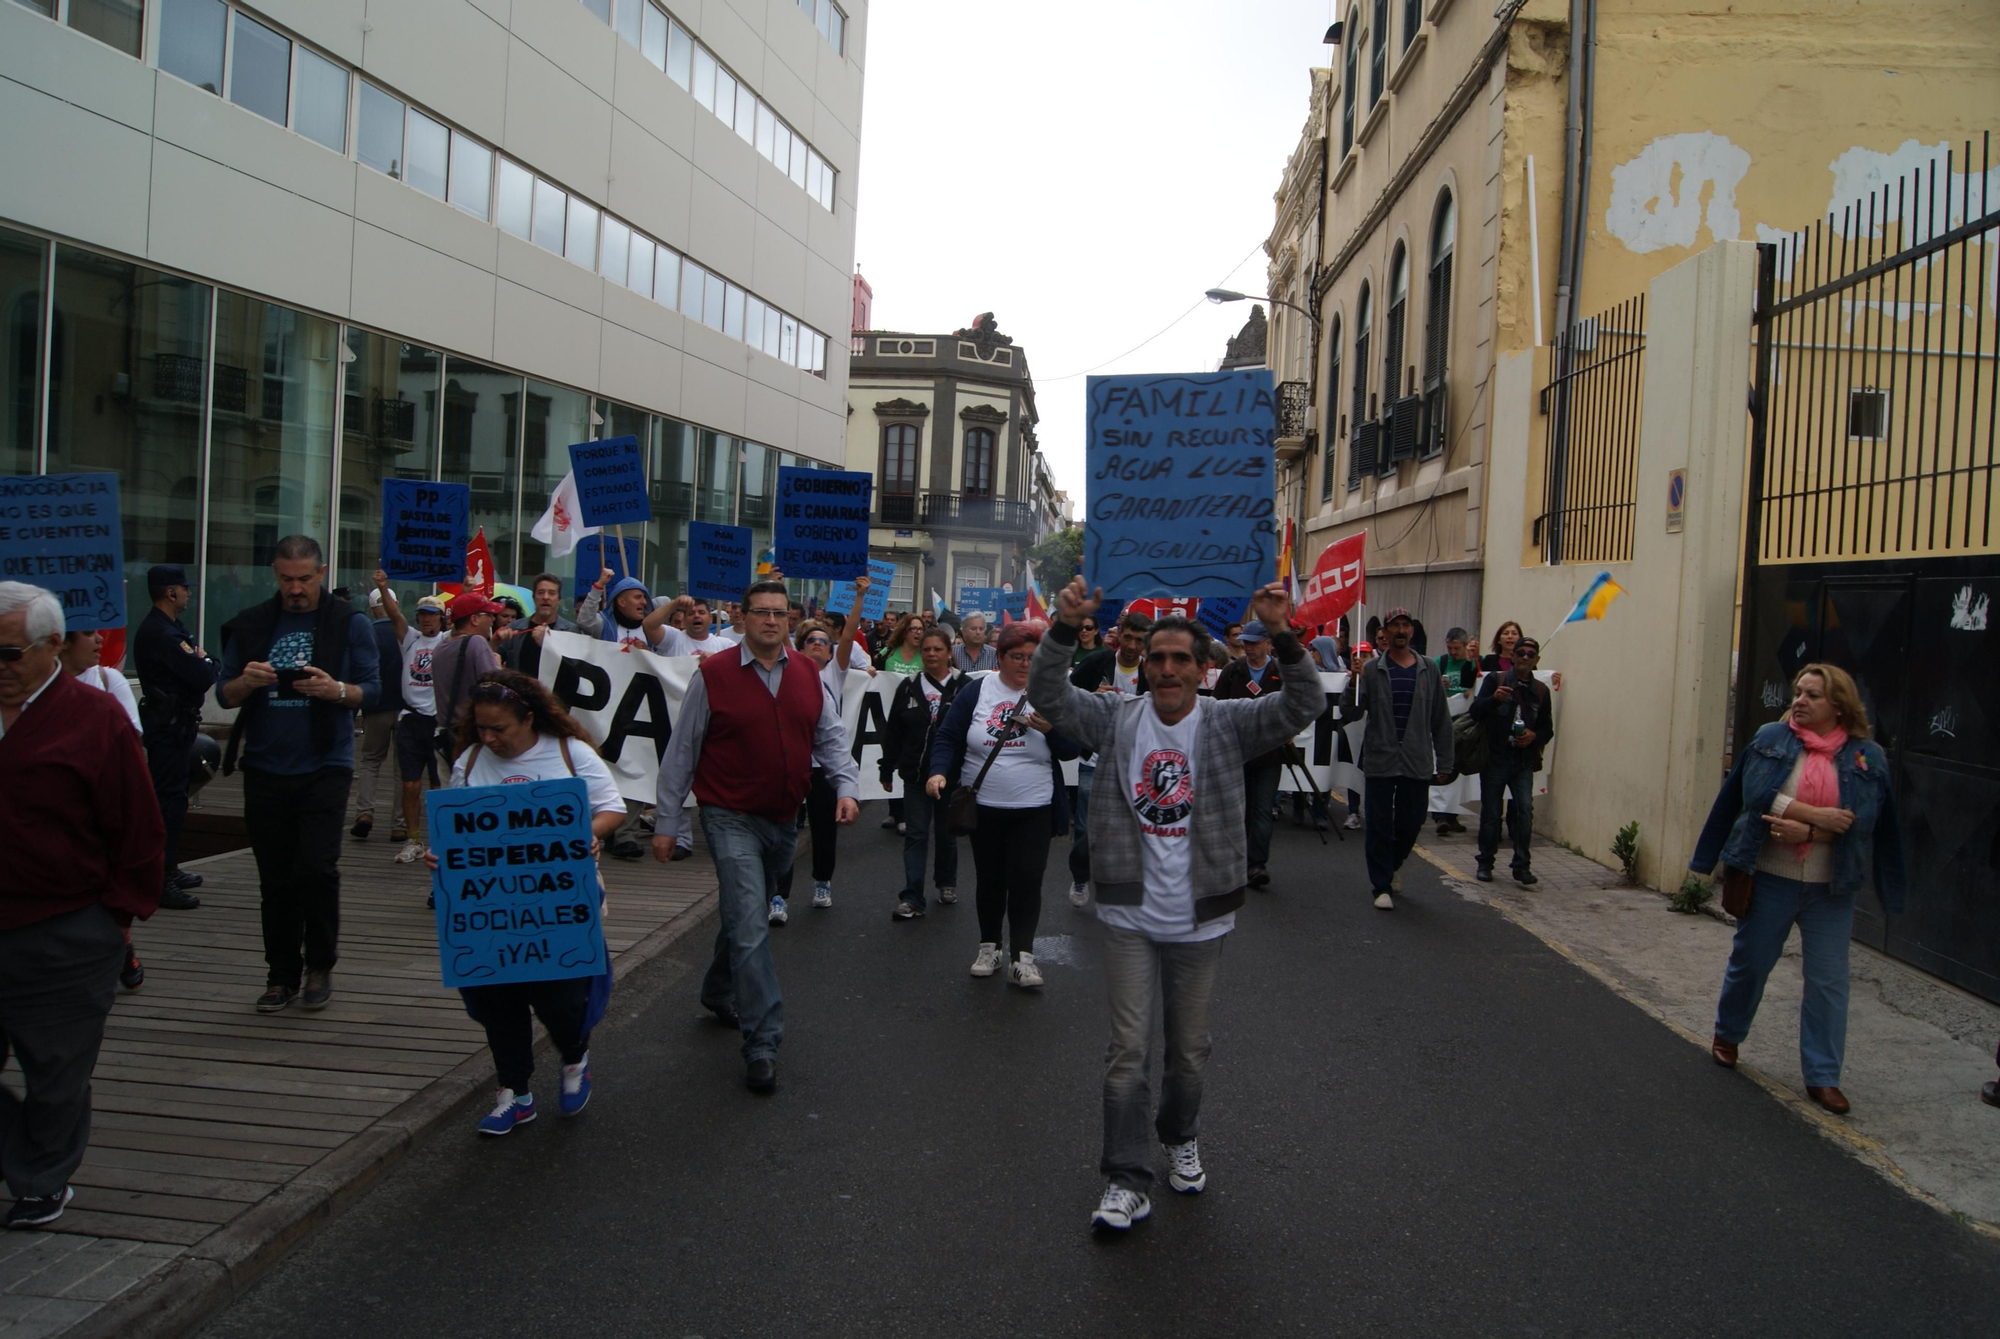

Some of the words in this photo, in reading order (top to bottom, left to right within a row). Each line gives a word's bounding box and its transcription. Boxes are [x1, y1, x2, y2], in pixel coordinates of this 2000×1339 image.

[1102, 387, 1274, 417] FAMILIA
[1103, 419, 1152, 447] SIN
[576, 446, 618, 461] PORQUE
[625, 444, 638, 453] NO
[584, 462, 636, 478] COMEMOS
[1095, 454, 1173, 480] AGUA
[1187, 456, 1266, 478] LUZ
[416, 488, 439, 509] PP
[584, 482, 640, 498] ESTAMOS
[27, 505, 51, 518] ES
[57, 503, 97, 517] QUE
[592, 499, 640, 515] HARTOS
[783, 503, 800, 519] DE
[804, 504, 870, 522] CANARIAS
[401, 510, 435, 523] BASTA
[437, 513, 451, 523] DE
[17, 525, 109, 539] CUENTEN
[714, 531, 734, 540] PAN
[794, 524, 858, 541] GOBIERNO
[399, 544, 433, 557] BASTA
[434, 546, 451, 558] DE
[702, 541, 746, 555] TRABAJO
[4, 556, 34, 575] QUE
[58, 554, 115, 574] TENGAN
[706, 555, 740, 568] TECHO
[783, 549, 801, 562] DE
[802, 549, 866, 567] CANALLAS
[454, 812, 499, 834] NO
[508, 805, 574, 829] MAS
[447, 840, 589, 870] ESPERAS
[461, 872, 575, 900] AYUDAS
[453, 903, 590, 933] SOCIALES
[499, 939, 550, 968] ¡YA!
